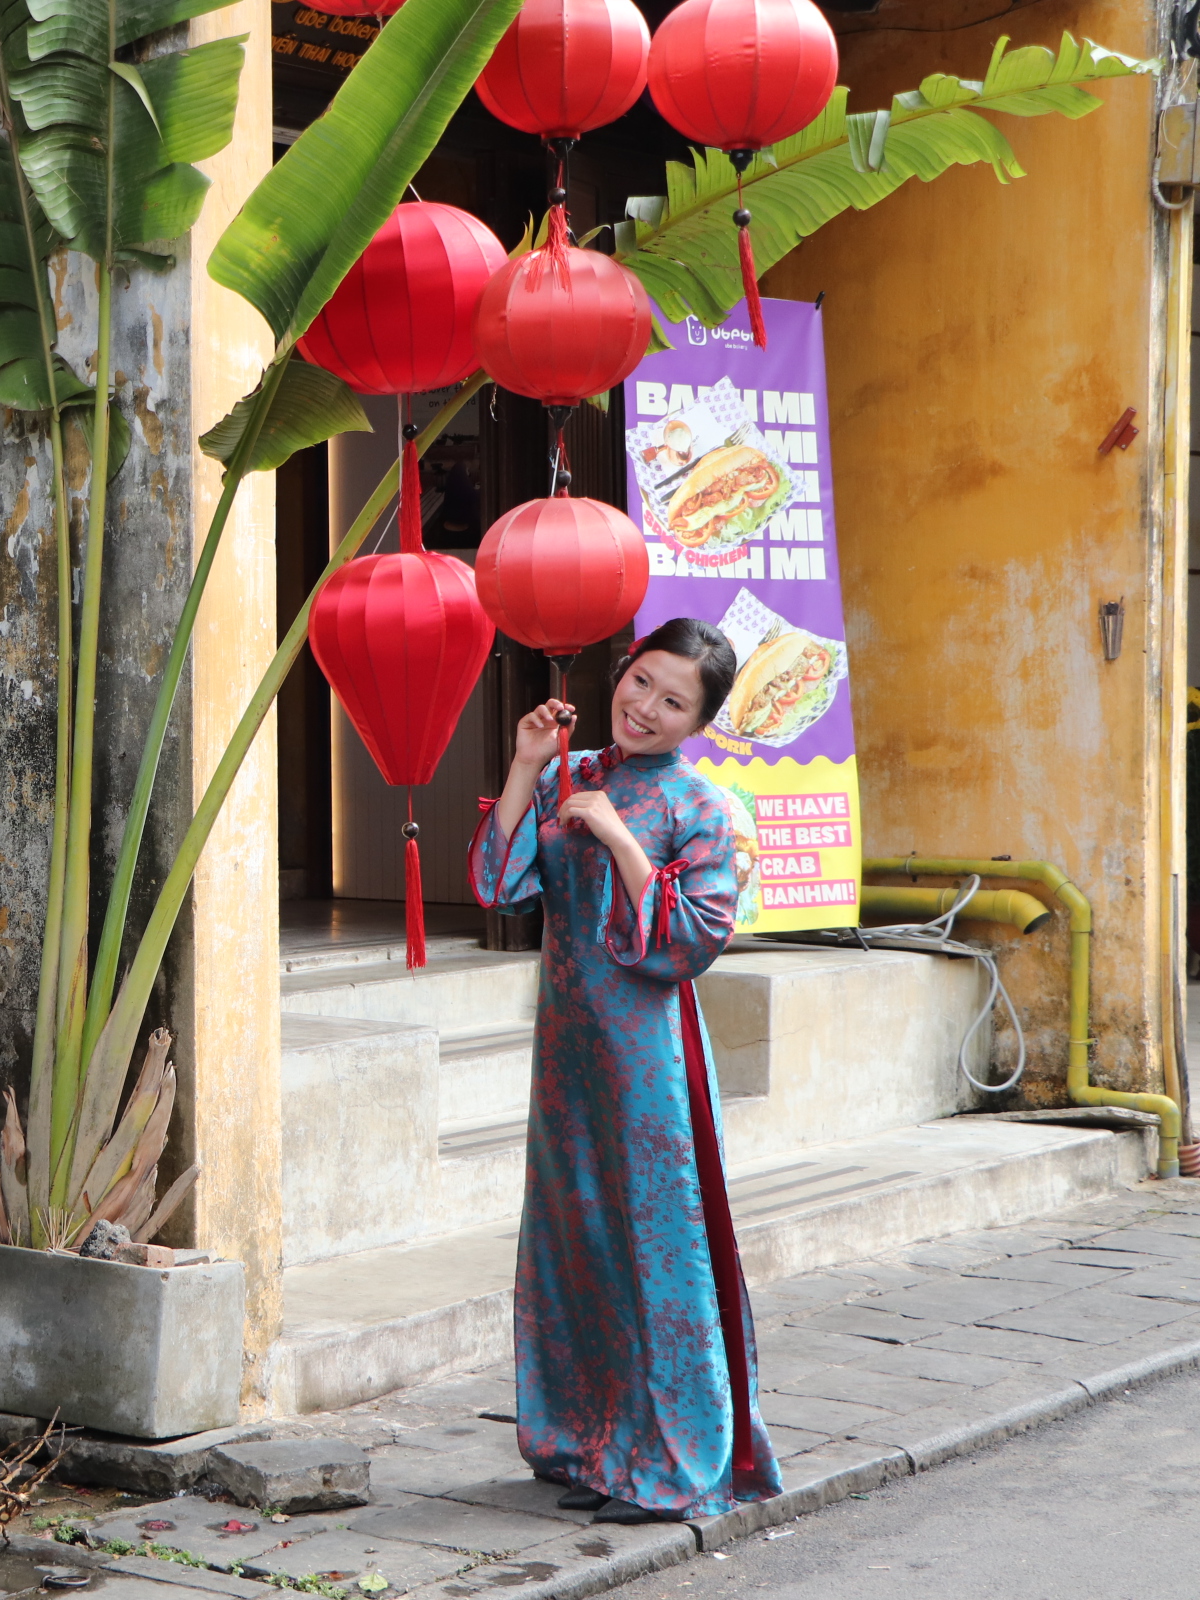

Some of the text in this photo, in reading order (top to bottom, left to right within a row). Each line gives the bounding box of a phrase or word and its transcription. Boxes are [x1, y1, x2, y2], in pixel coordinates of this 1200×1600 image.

[295, 8, 327, 28] ube
[297, 43, 332, 63] THÁI
[763, 390, 816, 425] MI
[765, 430, 818, 464] MI
[769, 509, 824, 541] MI
[685, 544, 748, 568] CHICKEN
[769, 547, 826, 580] MI
[757, 796, 846, 817] WE HAVE
[758, 825, 847, 846] THE BEST
[761, 856, 816, 876] CRAB
[763, 881, 855, 906] BANHMI!
